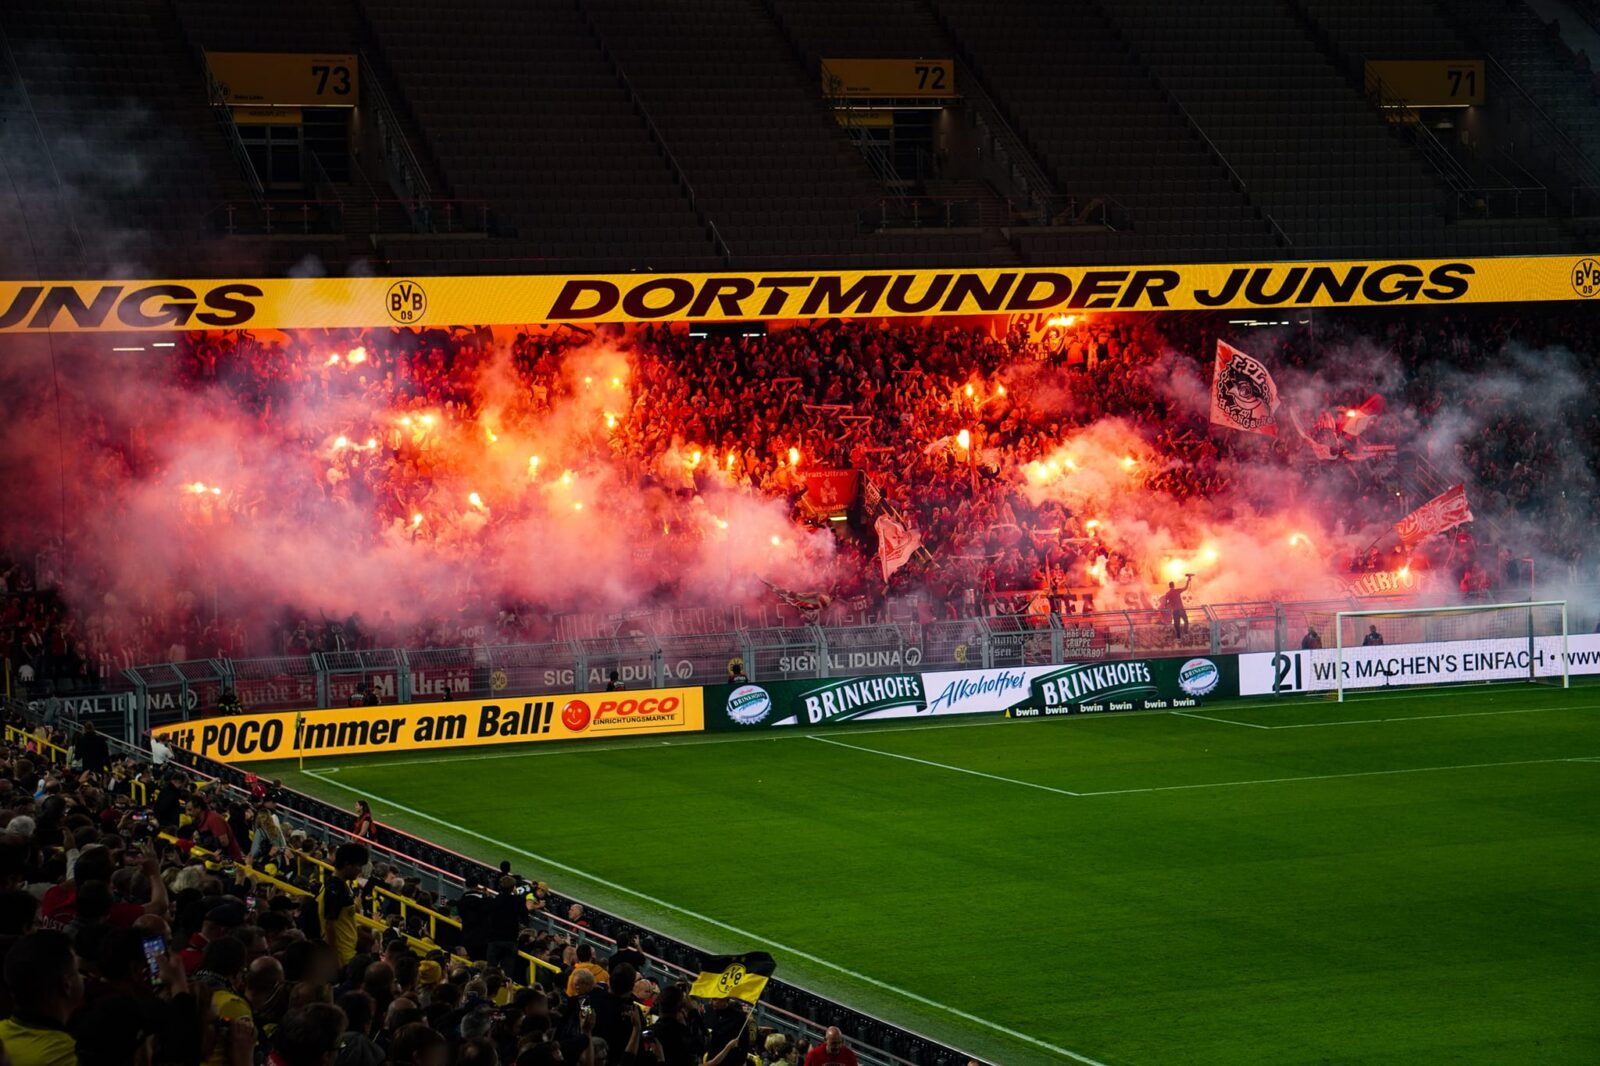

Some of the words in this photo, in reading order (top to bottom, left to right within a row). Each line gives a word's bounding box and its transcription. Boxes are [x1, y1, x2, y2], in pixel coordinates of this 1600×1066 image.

[311, 65, 352, 96] 73
[914, 66, 946, 90] 72
[1447, 69, 1476, 97] 71
[391, 284, 423, 311] BVB
[545, 269, 1181, 319] DORTMUNDER
[1193, 263, 1475, 306] JUNGS
[1582, 285, 1593, 294] 09
[401, 310, 413, 320] 09
[849, 650, 901, 668] IDUNA
[1356, 654, 1457, 678] MACHEN'S
[1463, 650, 1543, 672] EINFACH
[543, 667, 611, 686] SIGAL
[930, 670, 1026, 713] Alkoholfrei
[594, 696, 679, 720] POCO
[1016, 708, 1039, 717] bwin
[1045, 706, 1068, 715] bwin
[1080, 703, 1103, 713] bwin
[1109, 701, 1132, 711] bwin
[1144, 699, 1167, 709] bwin
[1173, 698, 1196, 707] bwin
[201, 719, 283, 756] POCO
[293, 717, 406, 750] immer
[413, 713, 467, 742] am
[477, 702, 554, 737] Ball!
